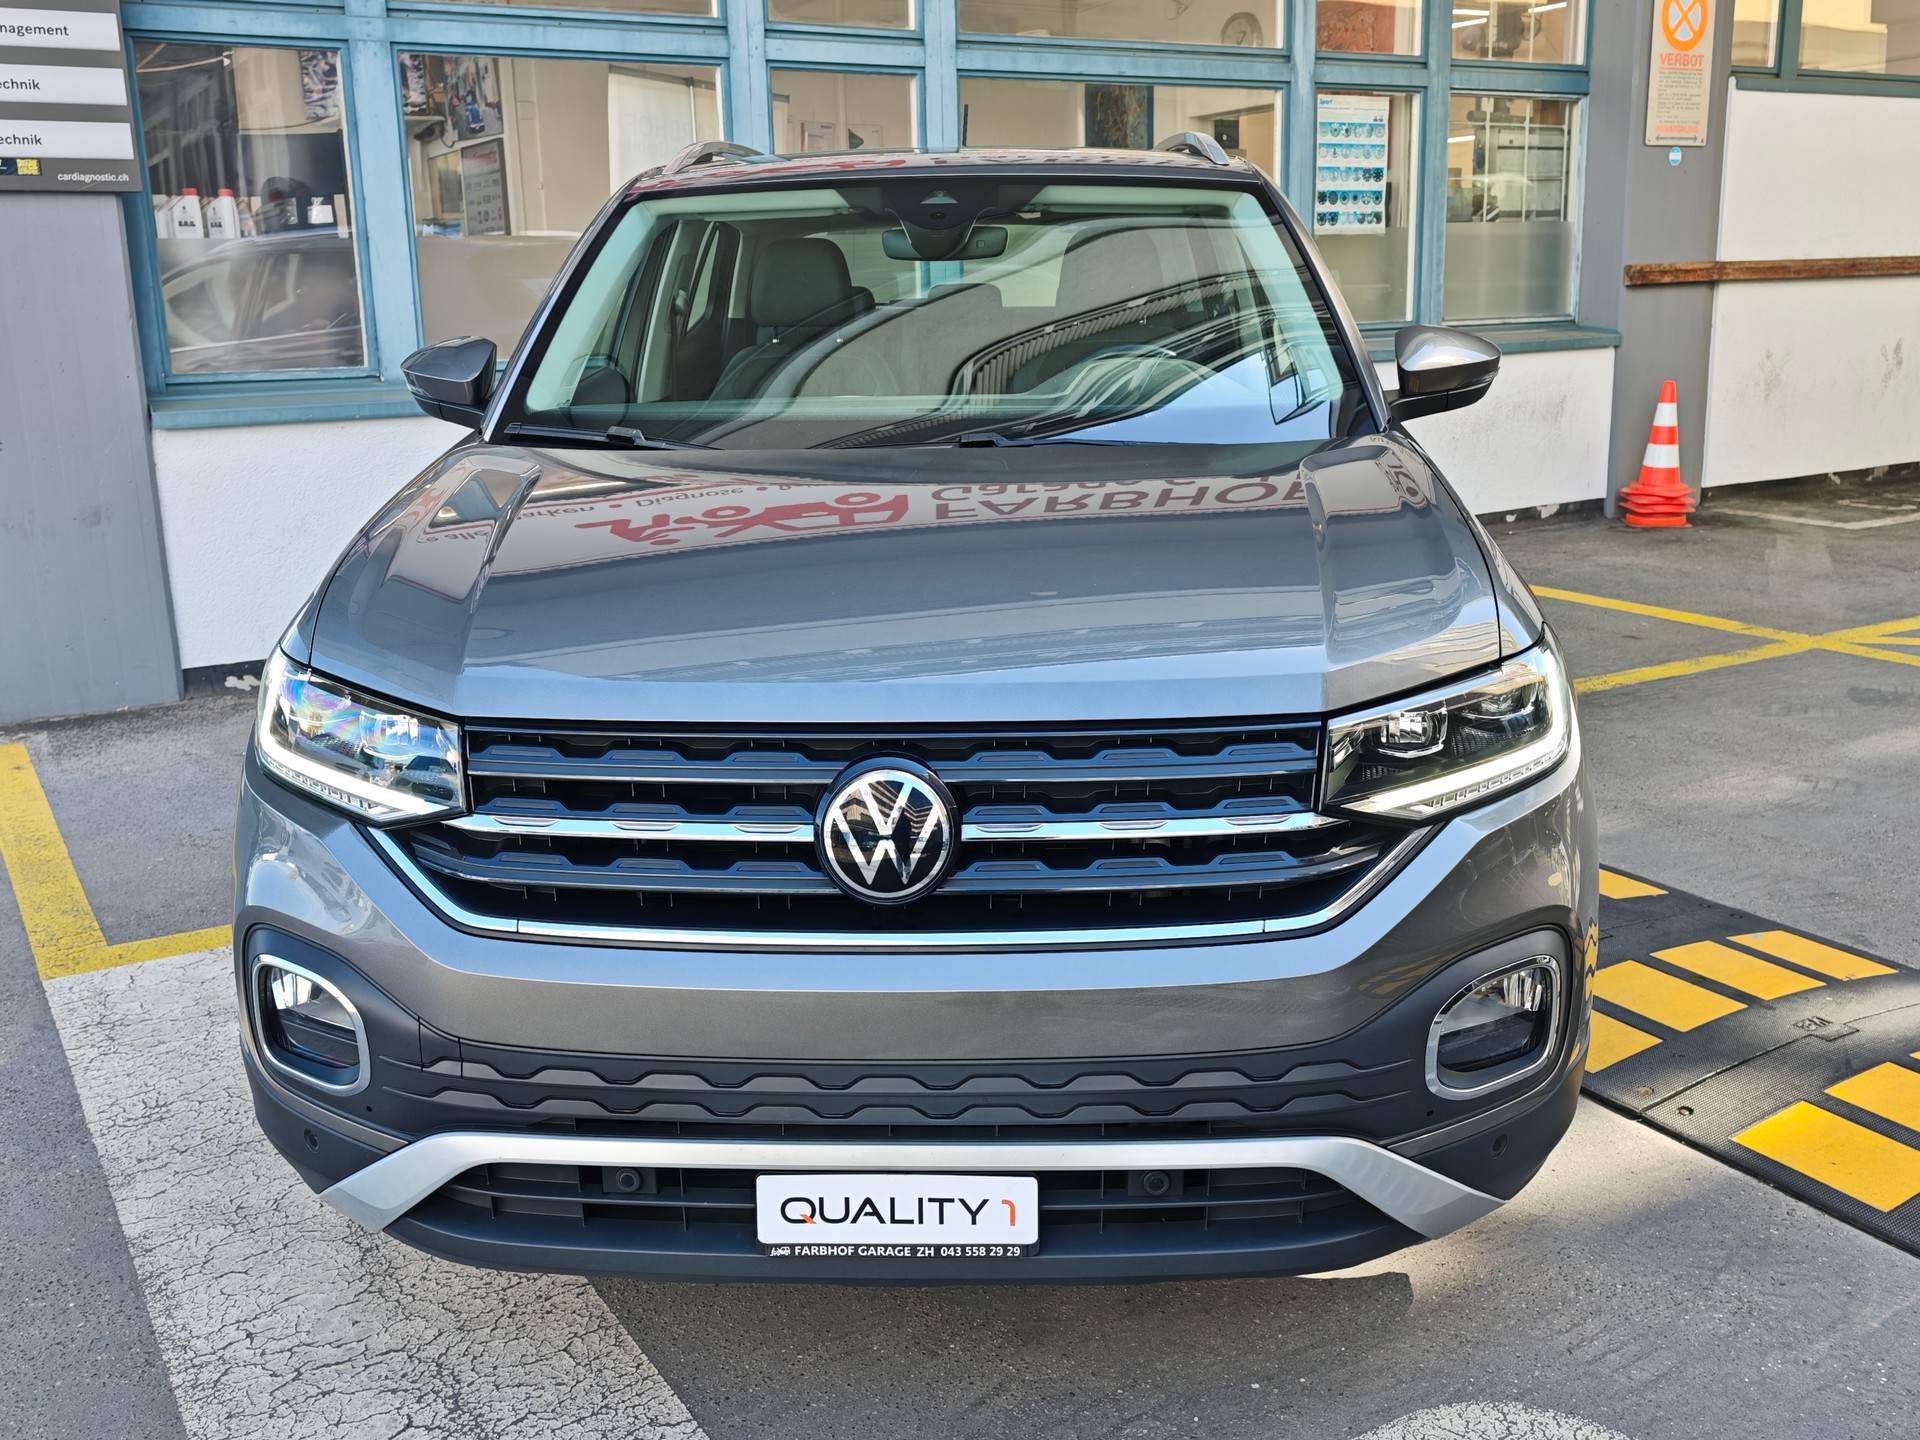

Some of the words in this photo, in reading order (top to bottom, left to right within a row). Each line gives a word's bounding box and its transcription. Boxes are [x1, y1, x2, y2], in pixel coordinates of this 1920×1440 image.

[1659, 53, 1704, 67] VERBOT
[0, 78, 41, 91] chnik
[57, 172, 129, 184] cardiagnostic.ch
[780, 1197, 990, 1226] QUALITY
[1001, 1199, 1016, 1227] 1
[795, 1245, 855, 1257] FARBHOF
[858, 1246, 912, 1257] GARAGE
[917, 1247, 935, 1258] ZH
[941, 1247, 962, 1257] 043
[966, 1247, 986, 1257] 558
[989, 1247, 1004, 1257] 29
[1007, 1247, 1021, 1257] 29
